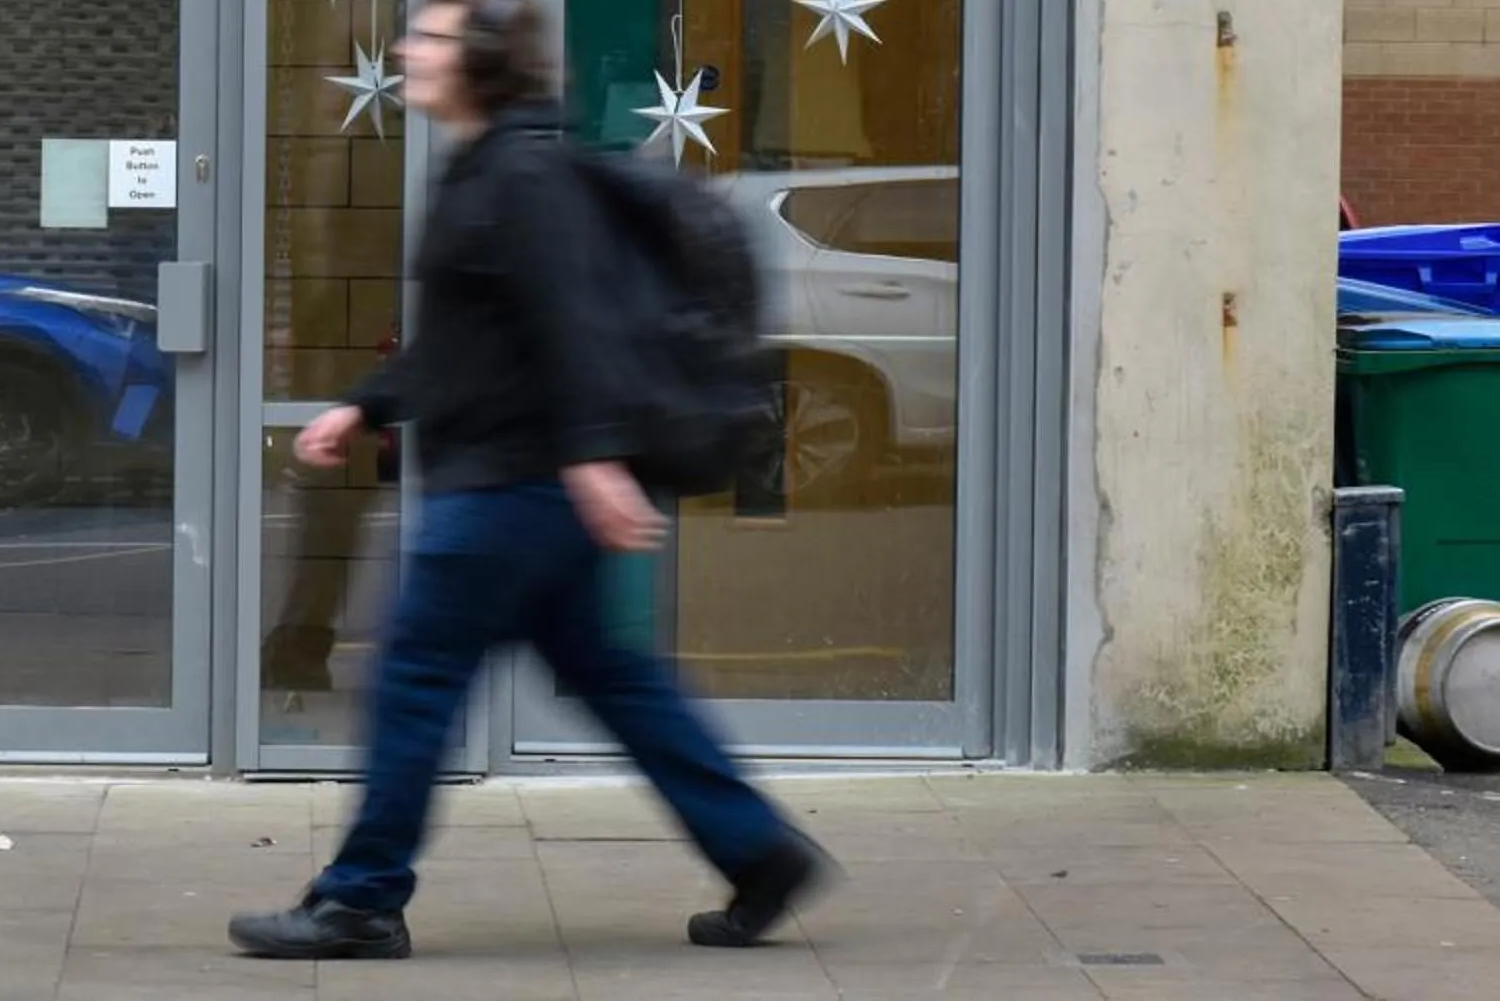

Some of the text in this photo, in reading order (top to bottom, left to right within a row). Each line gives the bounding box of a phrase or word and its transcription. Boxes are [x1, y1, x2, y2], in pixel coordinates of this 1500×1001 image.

[129, 145, 155, 156] Push
[125, 160, 159, 170] Button
[137, 176, 147, 184] to
[128, 190, 156, 200] Open
